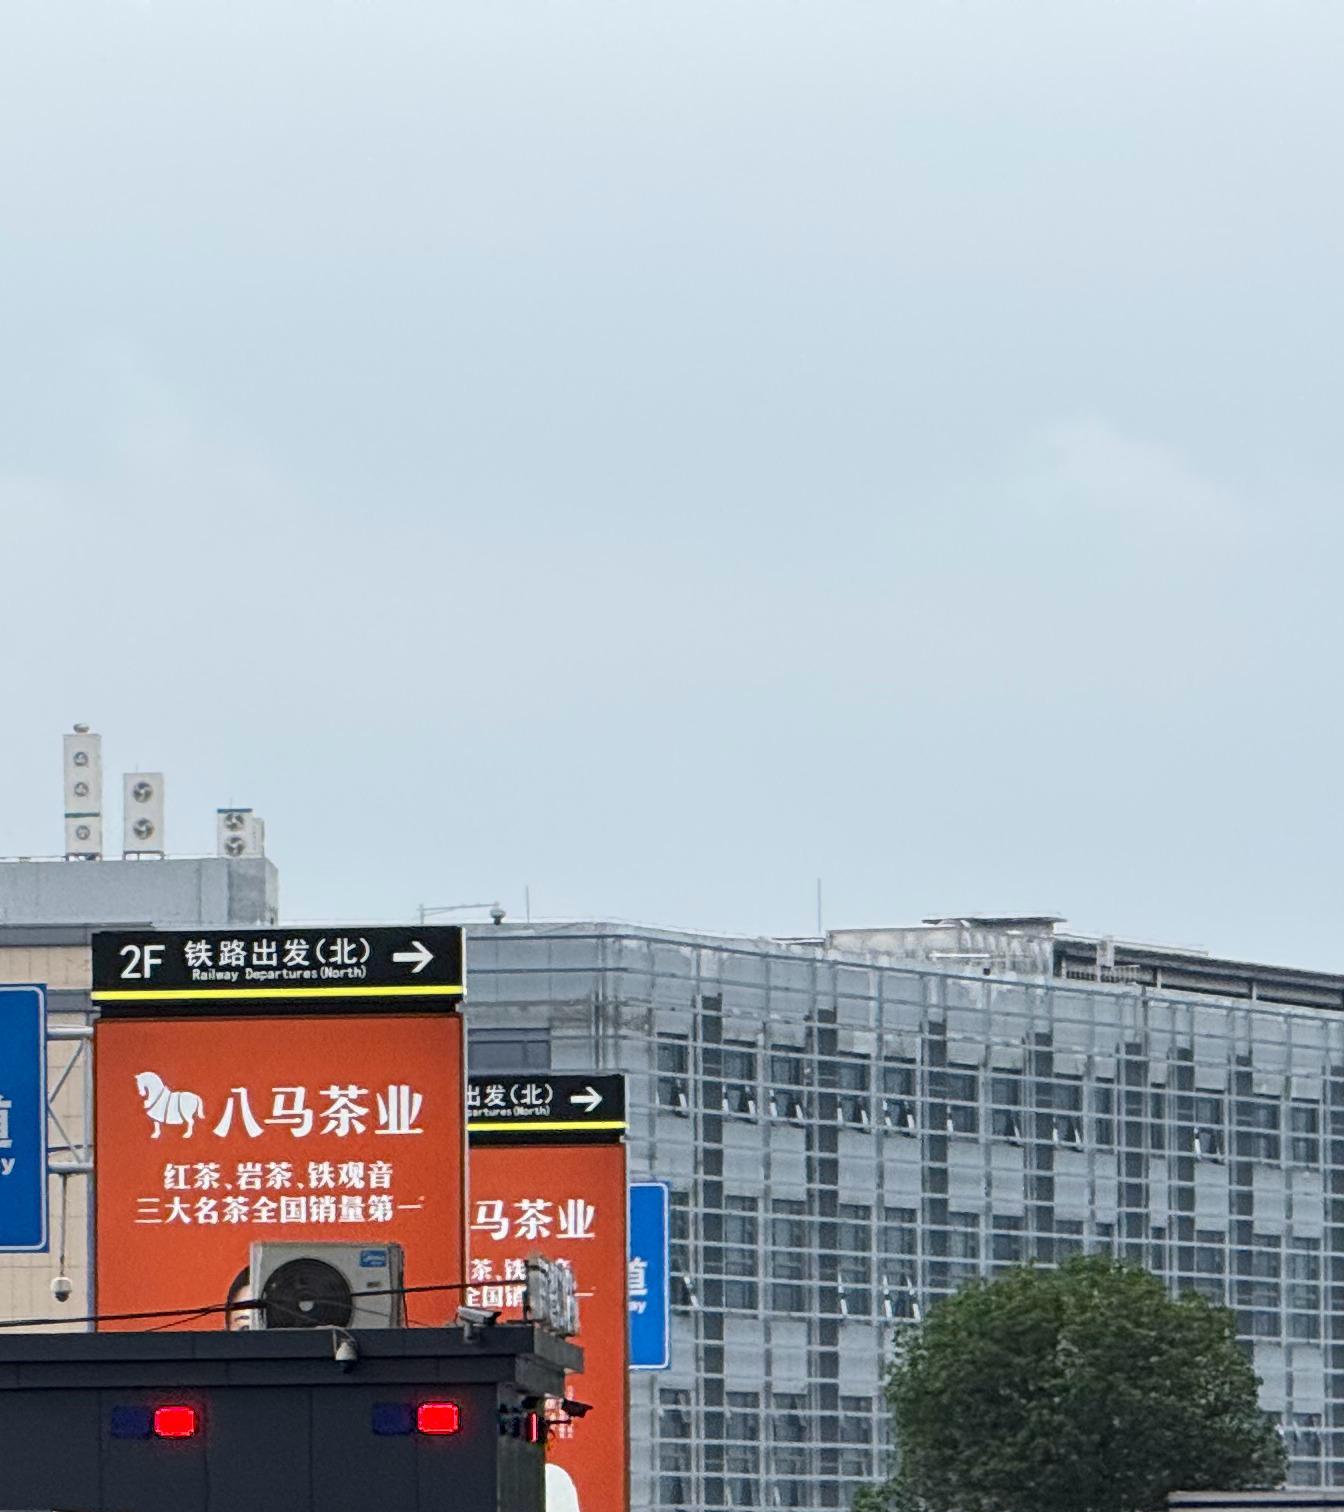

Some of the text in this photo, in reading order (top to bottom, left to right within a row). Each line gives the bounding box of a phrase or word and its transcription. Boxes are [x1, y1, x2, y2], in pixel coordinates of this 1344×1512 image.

[119, 944, 166, 979] 2F
[192, 968, 239, 982] Railway
[212, 1083, 425, 1138] 八马茶业
[163, 1160, 394, 1190] 红茶、岩茶、铁观音
[133, 1194, 425, 1225] 三大名茶全国销量第一
